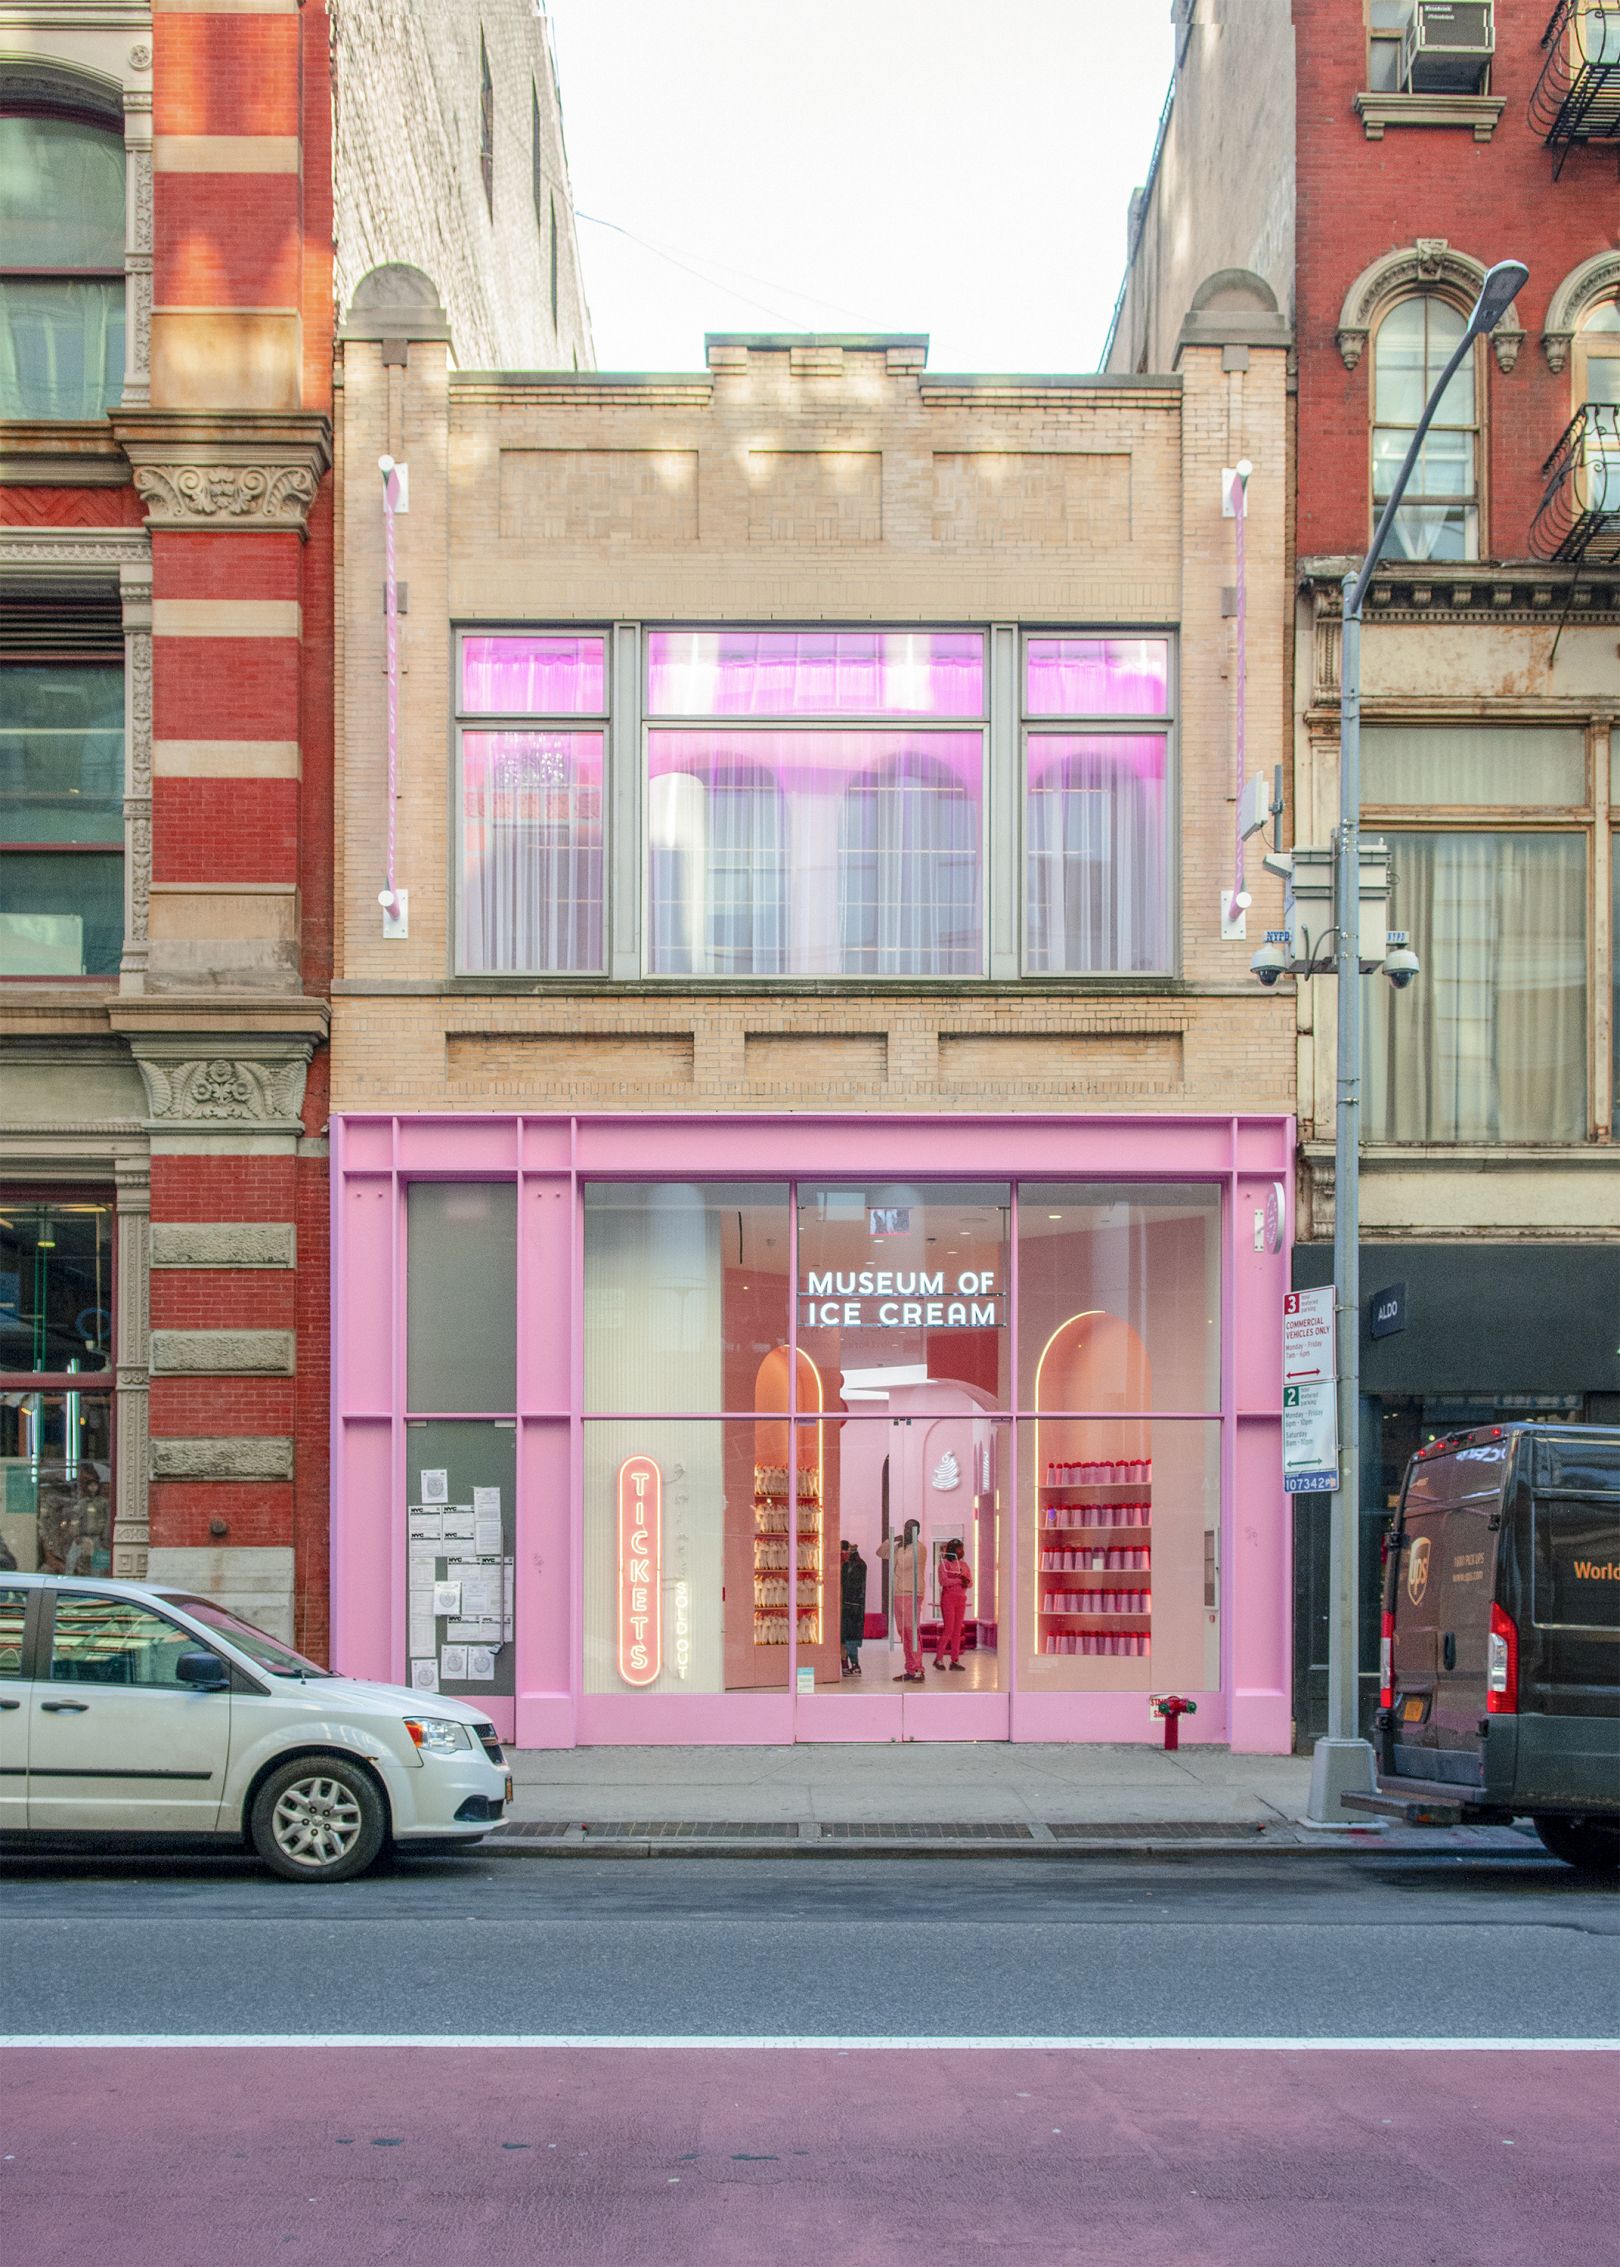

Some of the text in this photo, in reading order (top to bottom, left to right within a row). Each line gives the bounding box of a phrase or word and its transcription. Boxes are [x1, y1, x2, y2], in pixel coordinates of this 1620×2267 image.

[1266, 931, 1290, 942] NYPD
[1387, 932, 1406, 942] NYPD
[808, 1272, 995, 1294] MUSEUM OF
[1287, 1295, 1297, 1313] 3
[1378, 1301, 1398, 1321] ALDO
[809, 1303, 996, 1325] ICE CREAM
[1286, 1317, 1324, 1330] COMMERCIAL
[1286, 1326, 1330, 1340] VEHICLES ONLY
[1287, 1388, 1296, 1405] 2
[1286, 1477, 1325, 1490] 107342
[630, 1472, 650, 1670] TICKETS
[1408, 1557, 1429, 1595] ups
[675, 1581, 689, 1679] SOLD OUT
